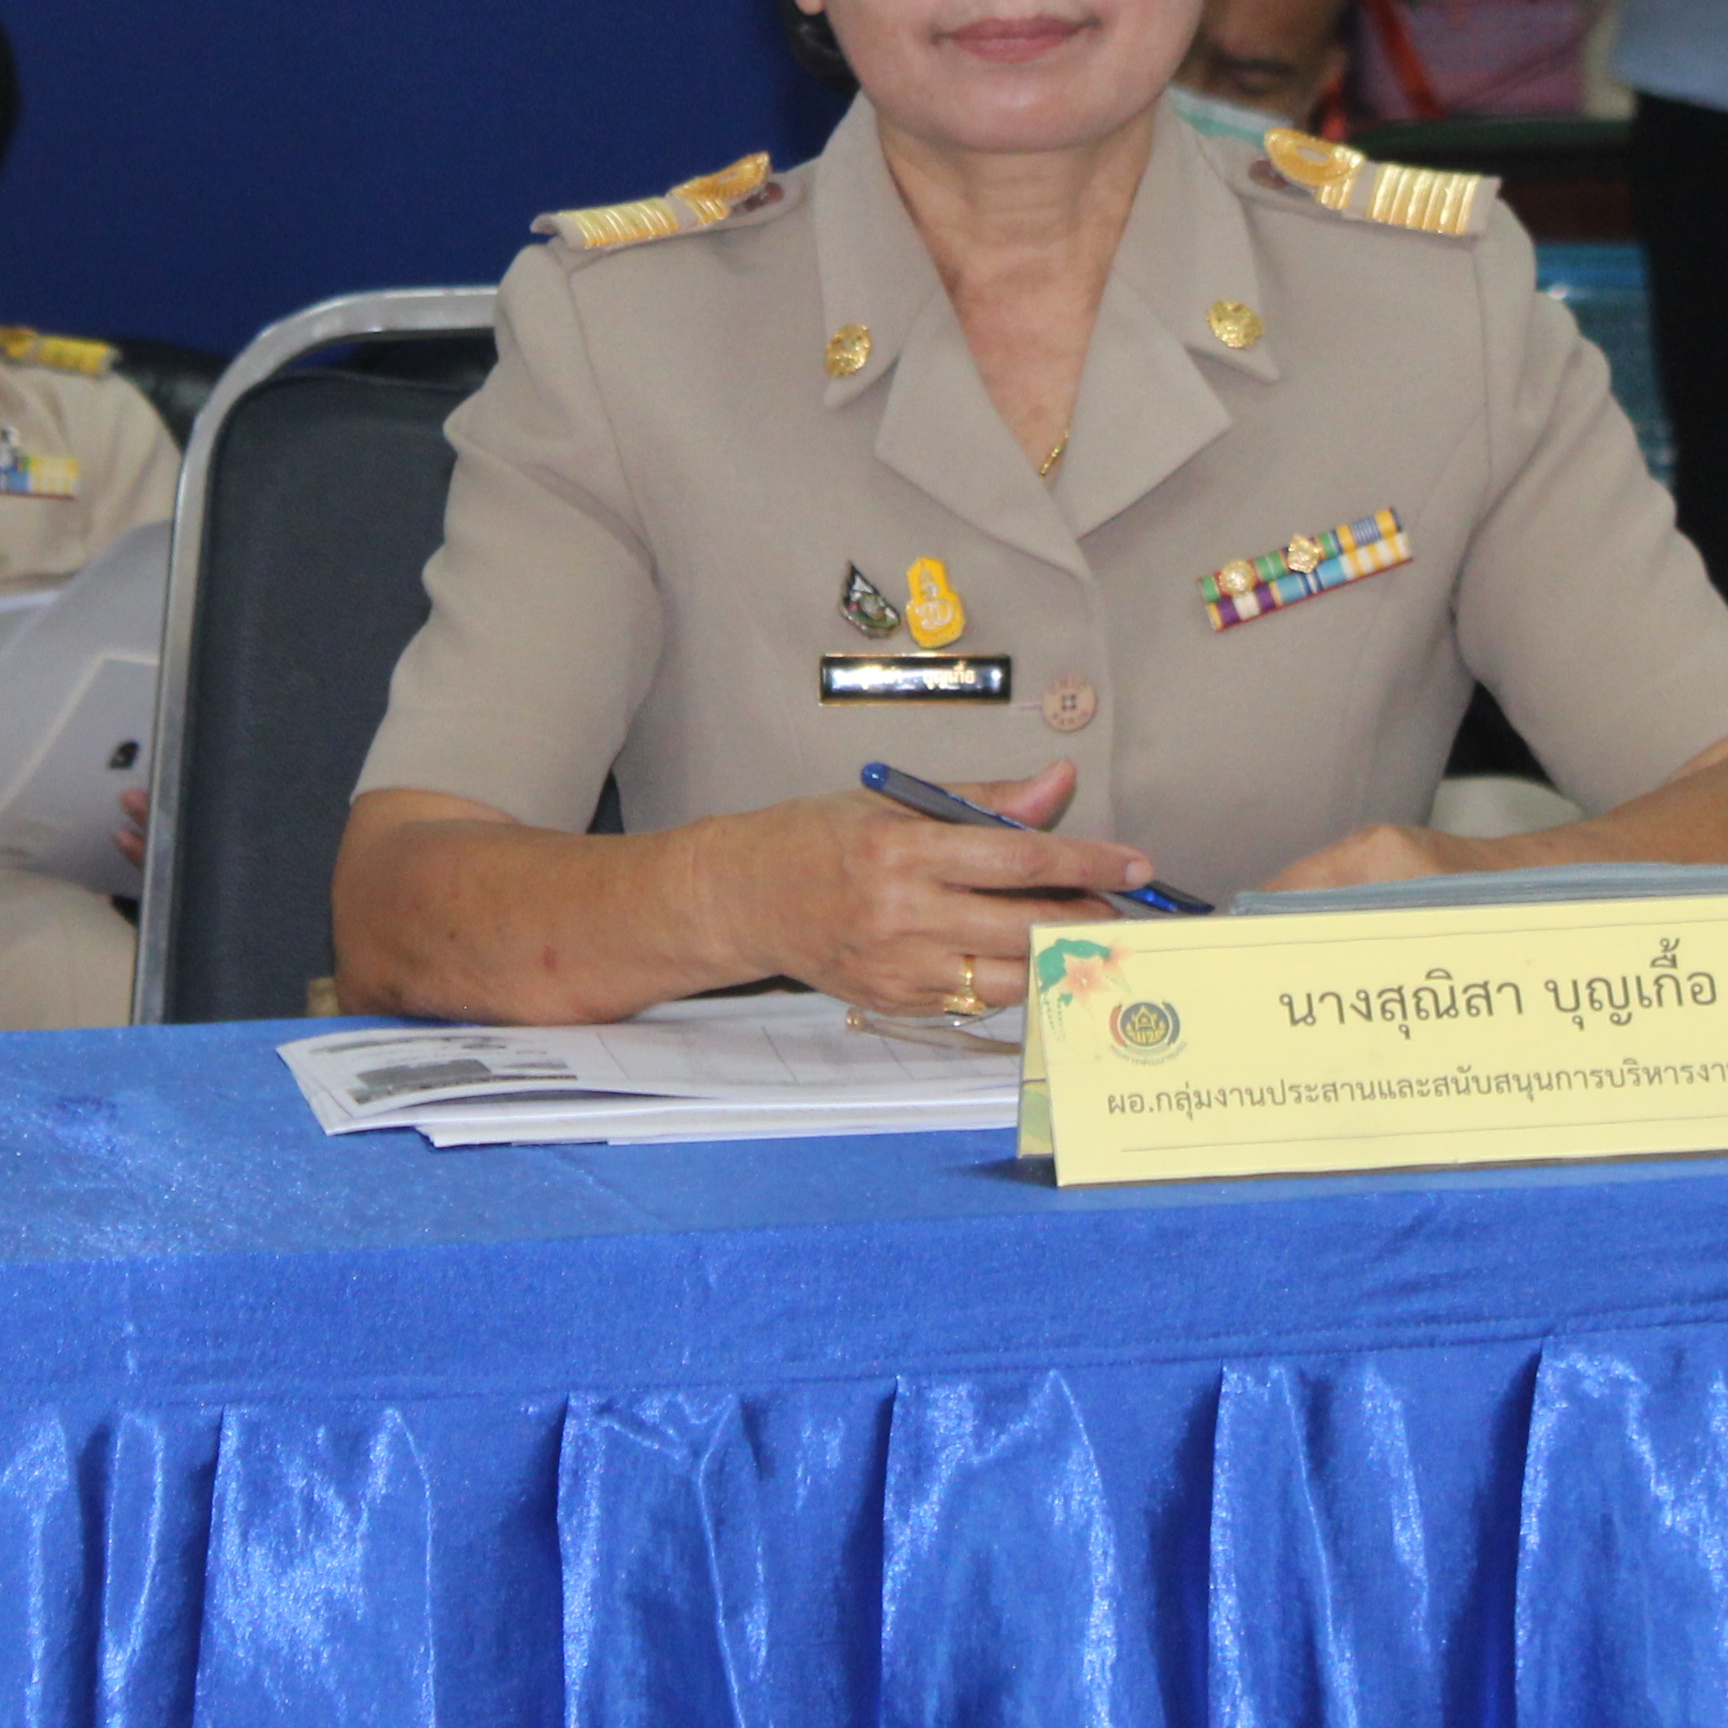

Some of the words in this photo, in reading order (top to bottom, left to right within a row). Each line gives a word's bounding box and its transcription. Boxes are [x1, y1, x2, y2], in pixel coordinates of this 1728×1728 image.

[1279, 968, 1522, 1039] นางสุณิสา
[1544, 938, 1718, 1030] บุญเกื้อ
